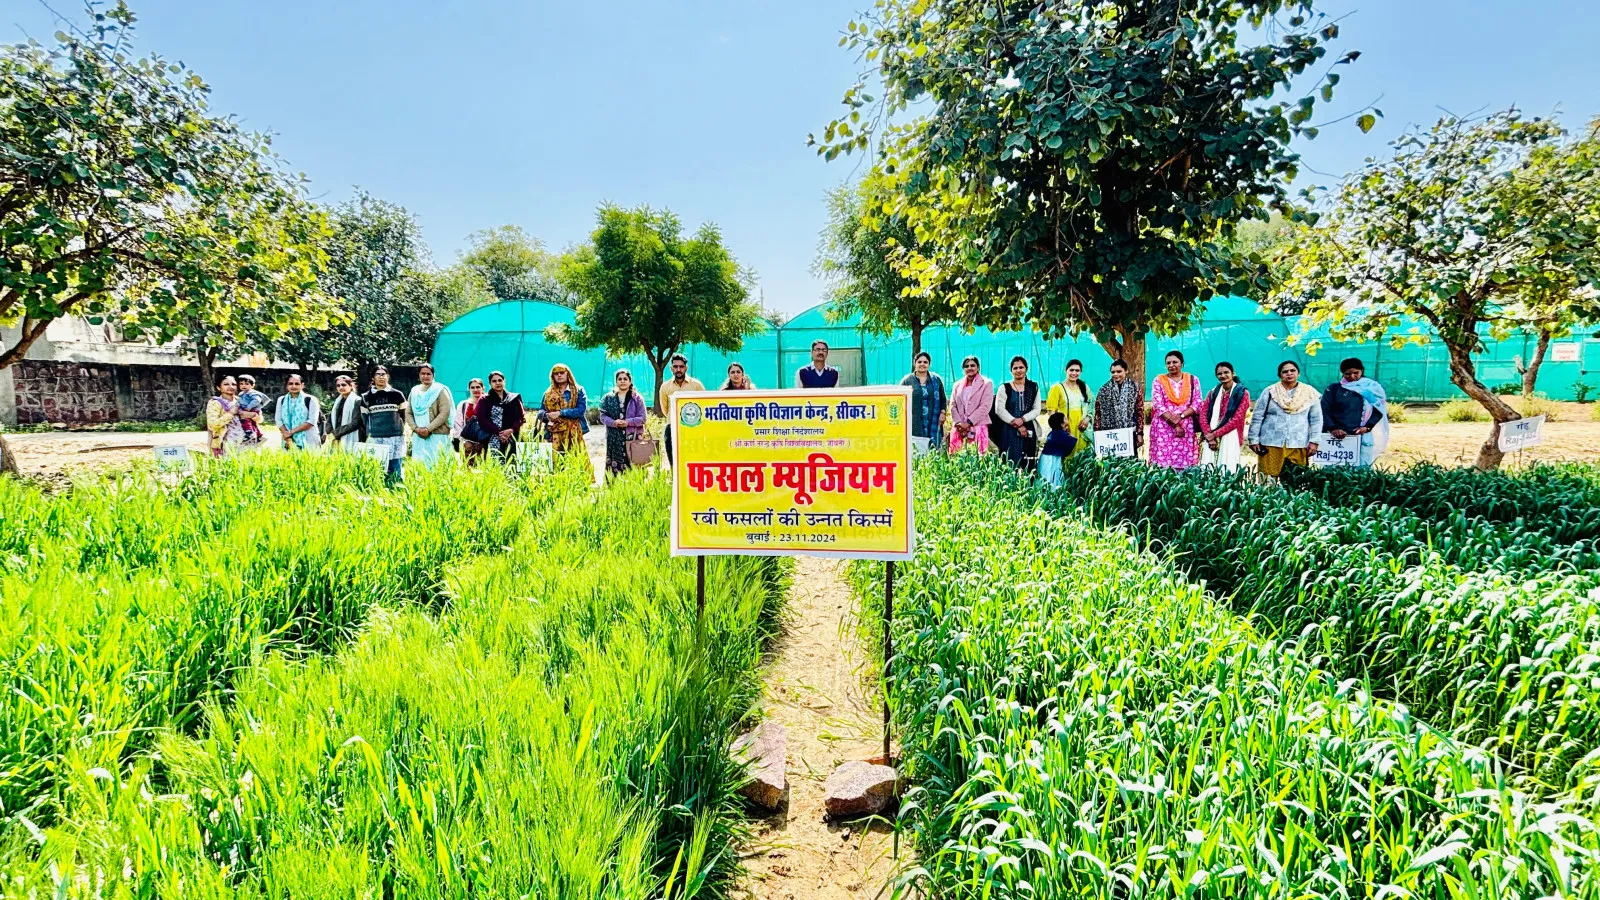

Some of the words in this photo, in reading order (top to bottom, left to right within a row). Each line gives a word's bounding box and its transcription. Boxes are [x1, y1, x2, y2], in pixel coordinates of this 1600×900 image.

[704, 402, 743, 421] भरतिया
[744, 402, 767, 426] कृषि
[768, 402, 804, 421] विज्ञान
[805, 401, 833, 422] केन्द्र,
[835, 401, 876, 420] सीकर-I
[754, 428, 771, 437] प्रसार
[772, 426, 791, 437] शिक्षा
[1099, 442, 1128, 455] Raj-4120
[1316, 450, 1354, 461] Raj-4238
[687, 463, 767, 492] फसल
[771, 453, 896, 505] म्यूजियम
[691, 508, 719, 526] रबी
[723, 507, 774, 526] फसलों
[777, 507, 801, 527] की
[804, 513, 843, 527] उन्नत
[846, 508, 894, 528] किस्में
[745, 531, 770, 545] बुवाई
[780, 533, 836, 543] 23.11.2024
